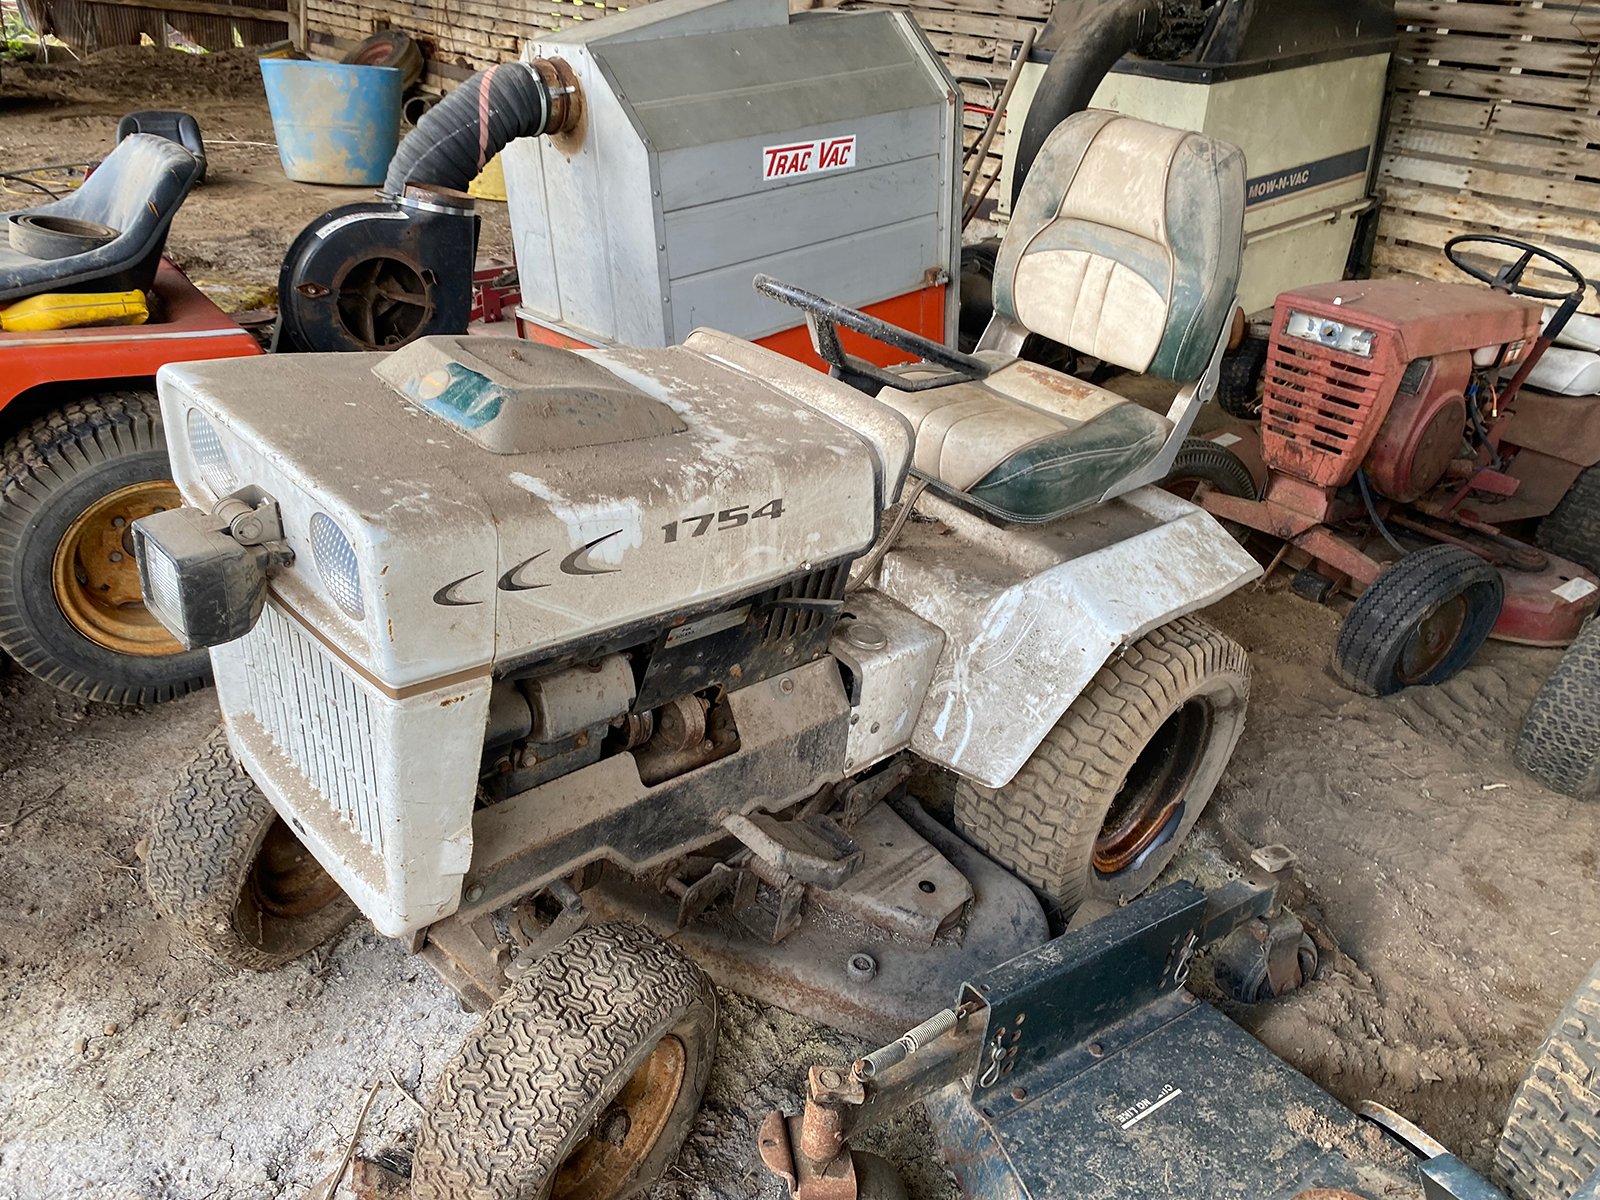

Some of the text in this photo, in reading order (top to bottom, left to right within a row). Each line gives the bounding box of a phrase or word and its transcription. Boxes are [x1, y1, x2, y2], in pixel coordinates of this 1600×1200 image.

[765, 137, 854, 177] TRAC VAC
[1248, 169, 1310, 199] MOW-N-VAC
[661, 498, 786, 544] 1754
